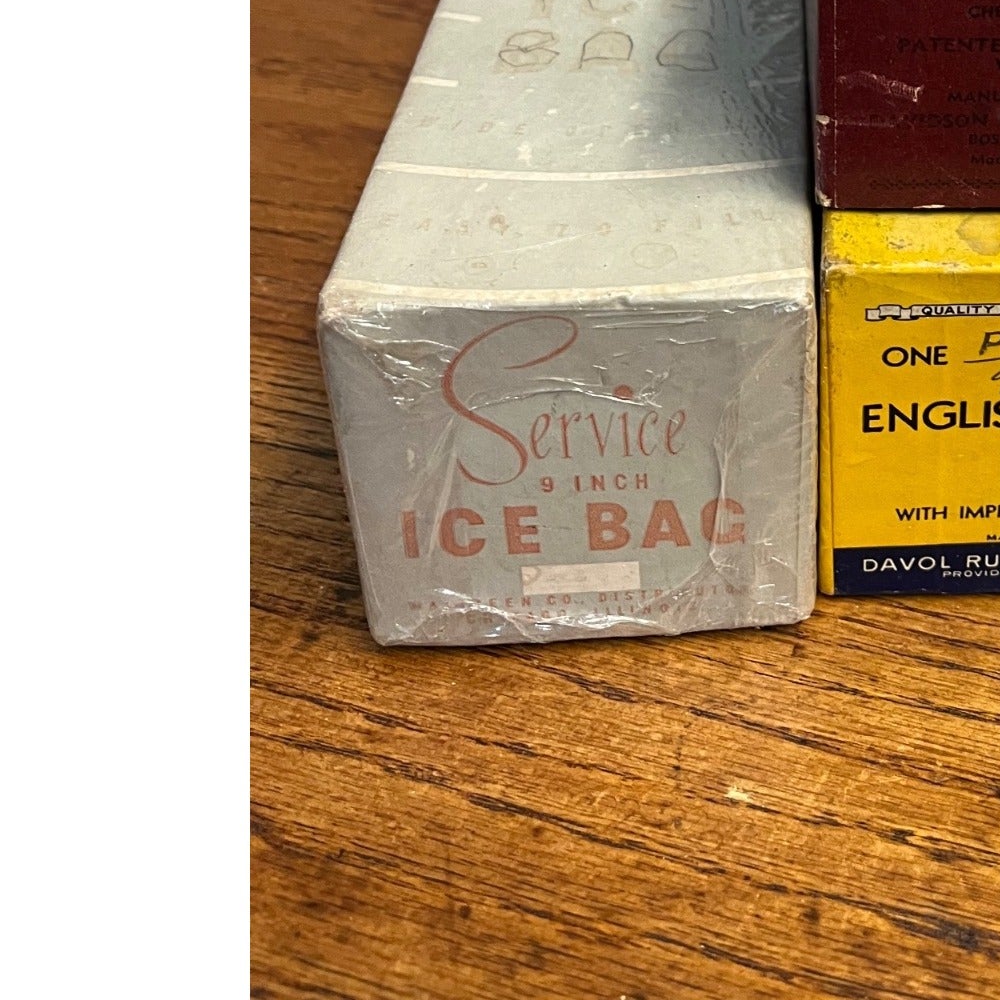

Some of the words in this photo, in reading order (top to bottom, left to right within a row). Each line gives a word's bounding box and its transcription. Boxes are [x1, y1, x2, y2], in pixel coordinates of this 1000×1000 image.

[920, 304, 995, 317] QUALITY
[881, 345, 949, 368] ONE
[440, 315, 687, 486] Service
[540, 476, 555, 494] 9
[574, 472, 650, 492] INCH
[895, 505, 948, 522] WITH
[401, 504, 542, 560] ICE
[586, 496, 747, 553] BAG
[862, 555, 951, 573] DAVOL
